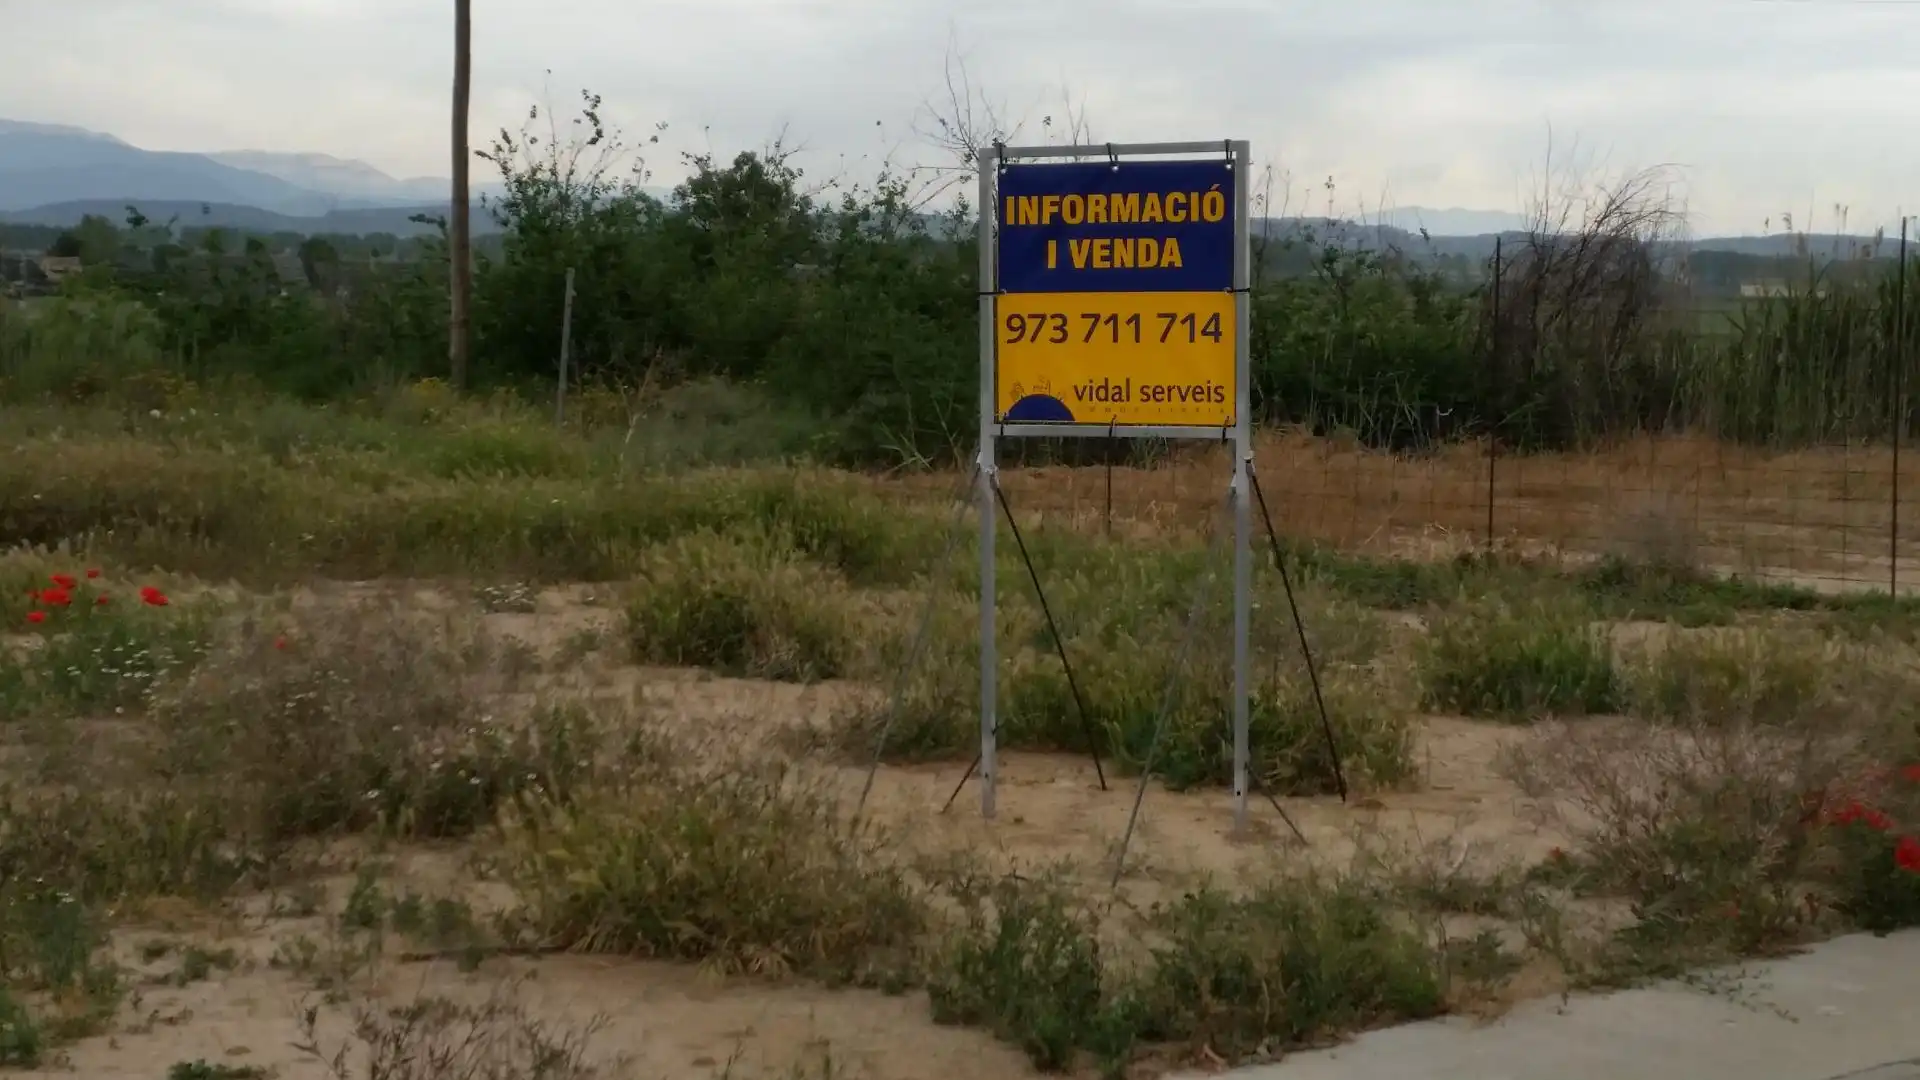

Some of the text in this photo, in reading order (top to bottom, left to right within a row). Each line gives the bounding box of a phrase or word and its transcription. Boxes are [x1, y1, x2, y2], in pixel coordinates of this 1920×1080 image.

[1006, 184, 1225, 225] INFORMACIÓ
[1047, 237, 1183, 269] I VENDA
[1006, 312, 1223, 344] 973 711 714
[1073, 377, 1225, 403] vidal serveis
